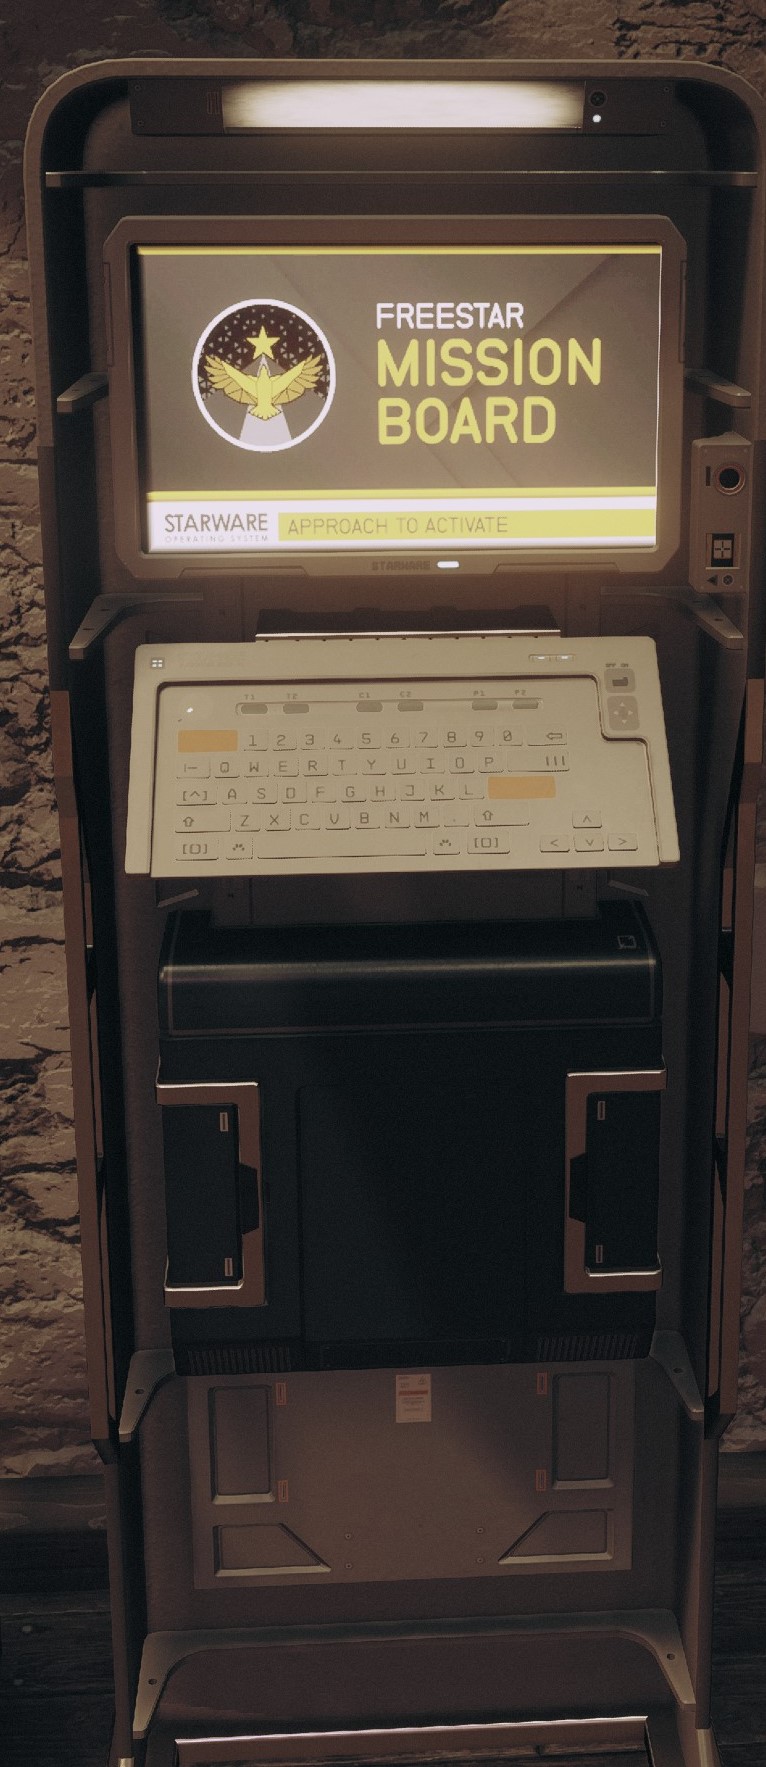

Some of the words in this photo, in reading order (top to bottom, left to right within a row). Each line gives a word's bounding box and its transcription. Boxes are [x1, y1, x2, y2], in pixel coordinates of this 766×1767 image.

[376, 302, 525, 330] FREESTAR
[377, 338, 602, 388] MISSION
[378, 396, 557, 446] BOARD
[164, 513, 268, 533] STARWARE
[288, 518, 388, 535] APPROACH
[395, 517, 418, 534] TO
[425, 516, 509, 534] ACTIVATE
[164, 535, 225, 544] OPERATING
[231, 534, 268, 543] SYSTEM
[249, 734, 258, 747] 1
[276, 734, 286, 746] 2
[305, 733, 315, 746] 3
[333, 733, 342, 745] 4
[361, 733, 371, 745] 5
[390, 732, 400, 744] 6
[419, 732, 428, 743] 7
[447, 731, 457, 743] 8
[475, 731, 484, 742] 9
[220, 762, 230, 773] Q
[250, 761, 259, 773] W
[278, 761, 288, 772] E
[308, 760, 318, 771] R
[337, 760, 346, 771] T
[367, 759, 376, 770] Y
[397, 759, 406, 770] U
[426, 758, 436, 769] I
[484, 757, 494, 768] P
[227, 788, 237, 800] A
[257, 788, 266, 799] S
[315, 787, 325, 798] F
[345, 786, 355, 798] G
[375, 786, 385, 797] H
[405, 785, 415, 796] J
[435, 784, 445, 796] K
[464, 784, 474, 796] L
[240, 815, 250, 827] Z
[269, 814, 279, 826] X
[299, 813, 310, 825] C
[330, 813, 340, 825] V
[359, 812, 369, 824] B
[389, 812, 399, 824] N
[419, 811, 429, 822] M
